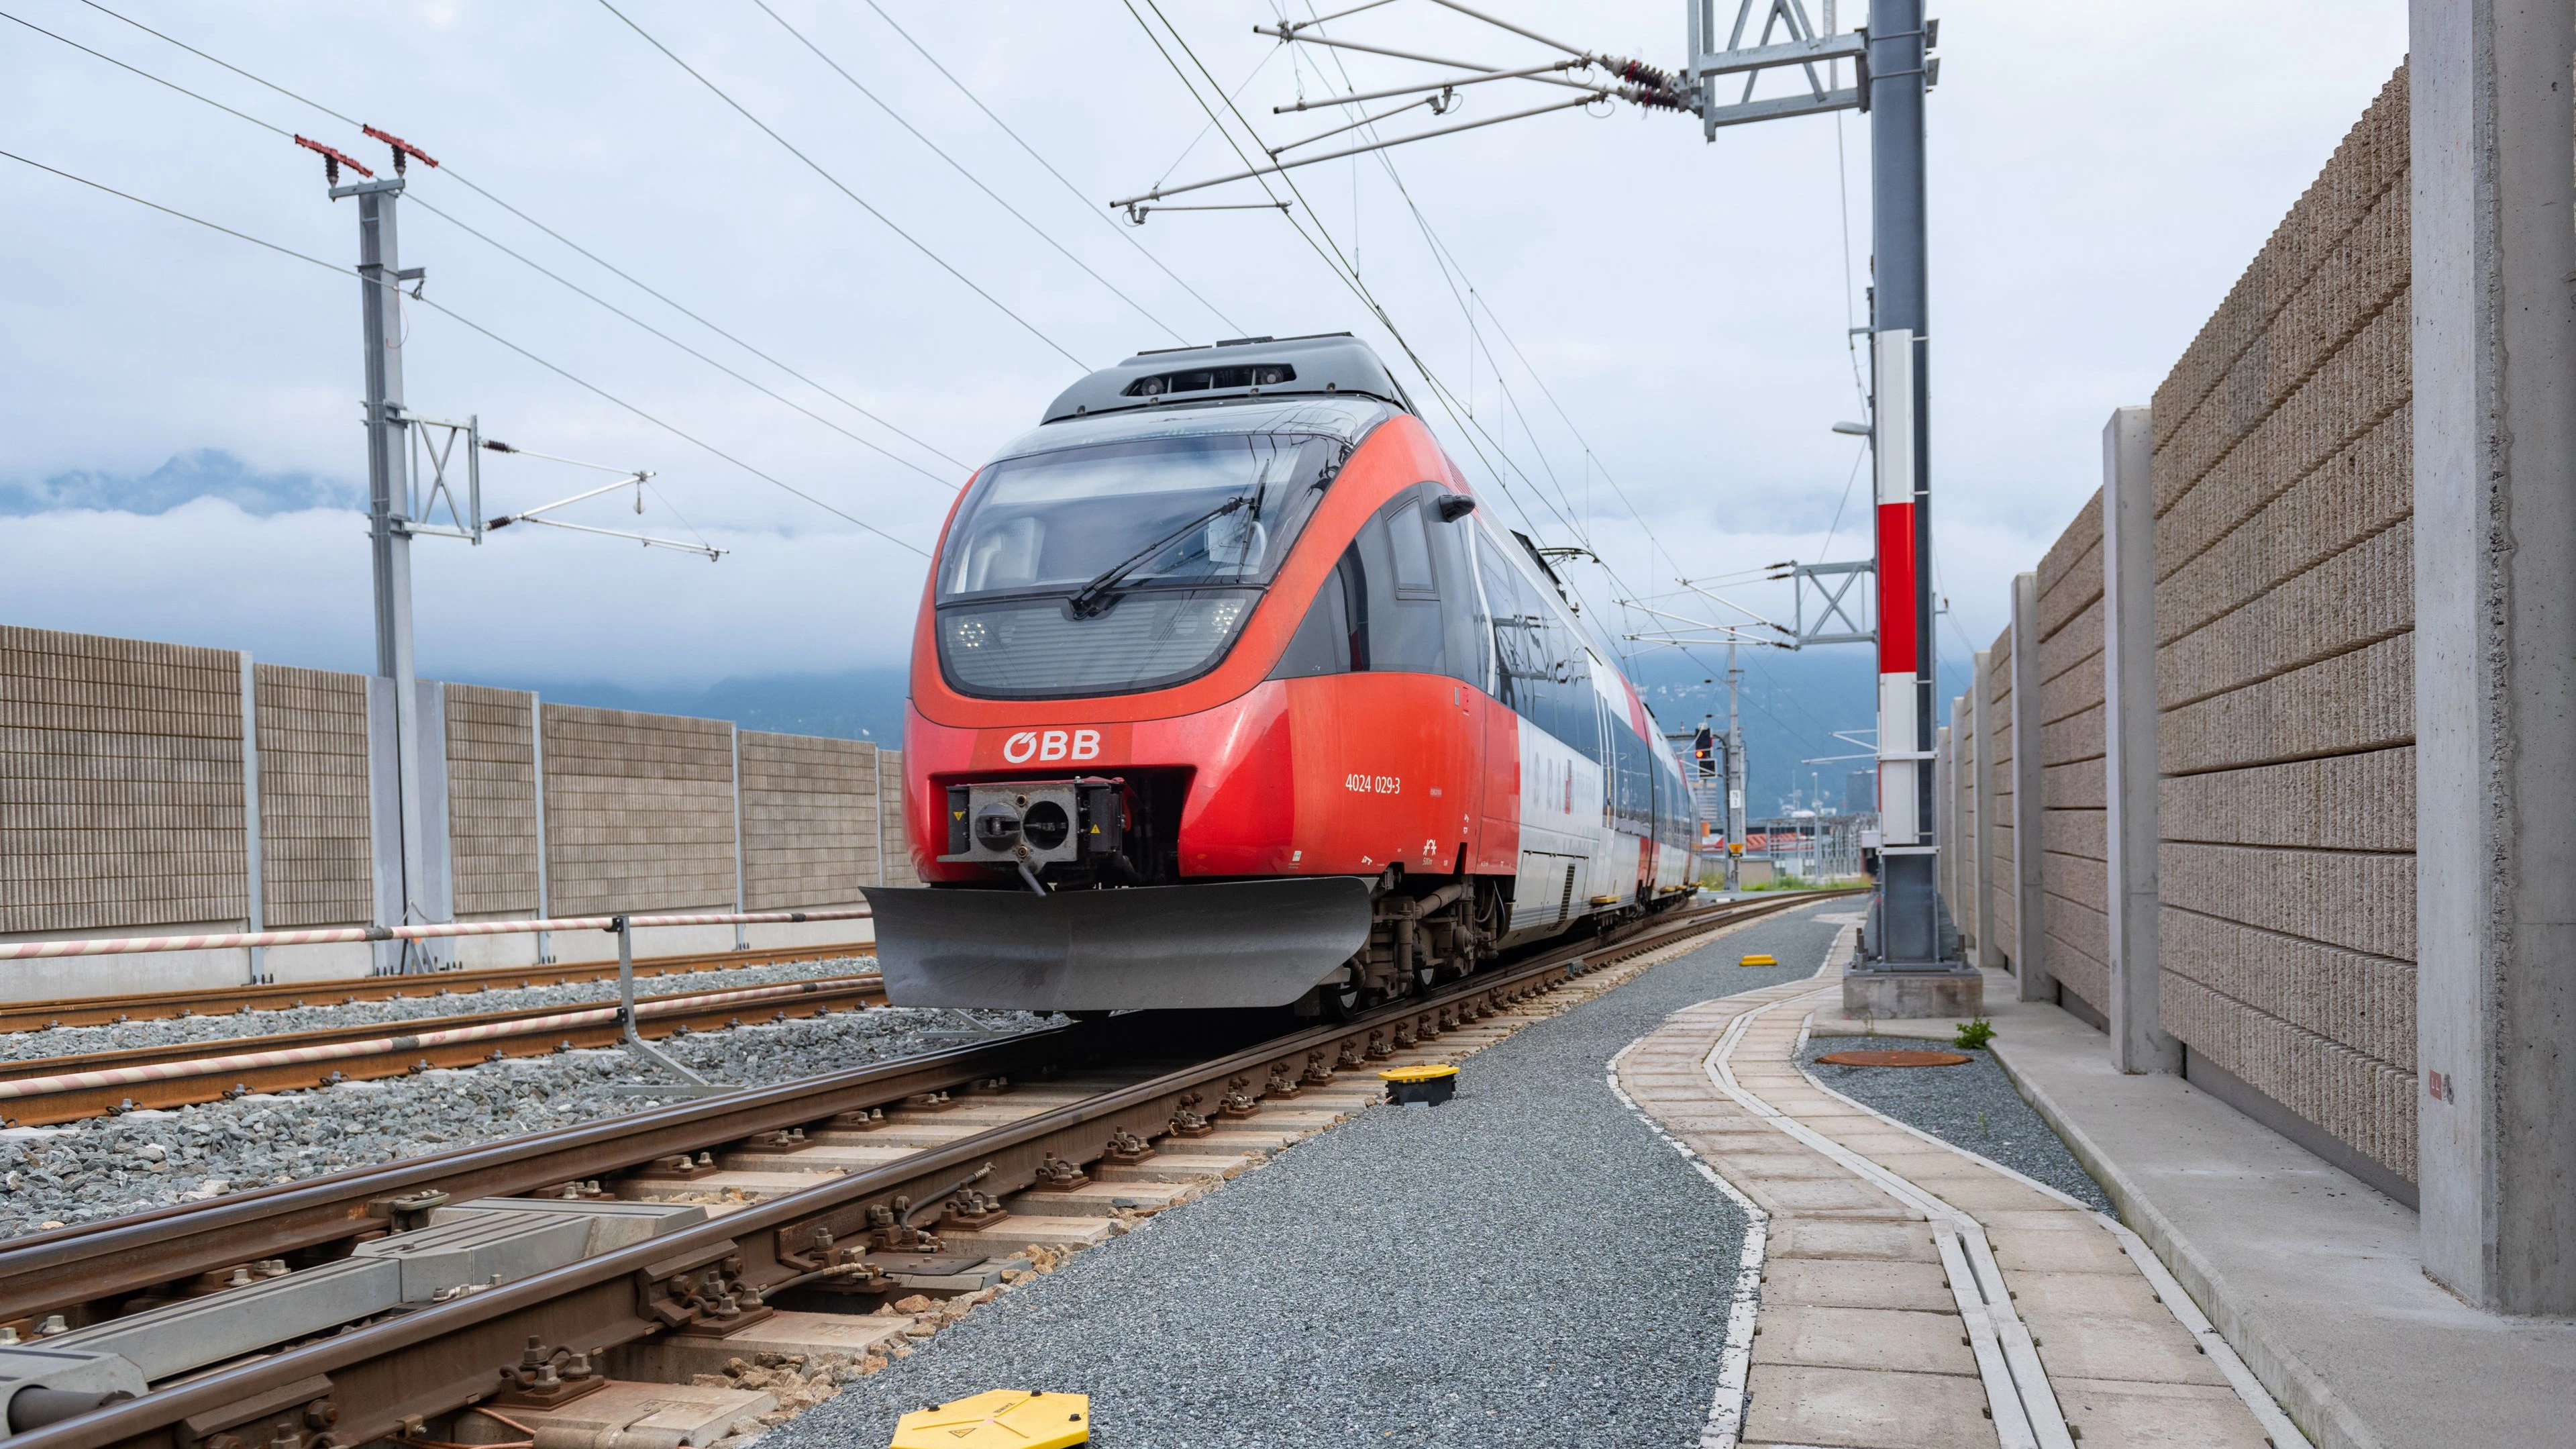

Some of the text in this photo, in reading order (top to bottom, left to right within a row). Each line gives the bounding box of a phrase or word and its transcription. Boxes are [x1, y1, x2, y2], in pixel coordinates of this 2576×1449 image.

[1003, 729, 1100, 764] ÖBB
[1345, 773, 1400, 795] 4024 029-3
